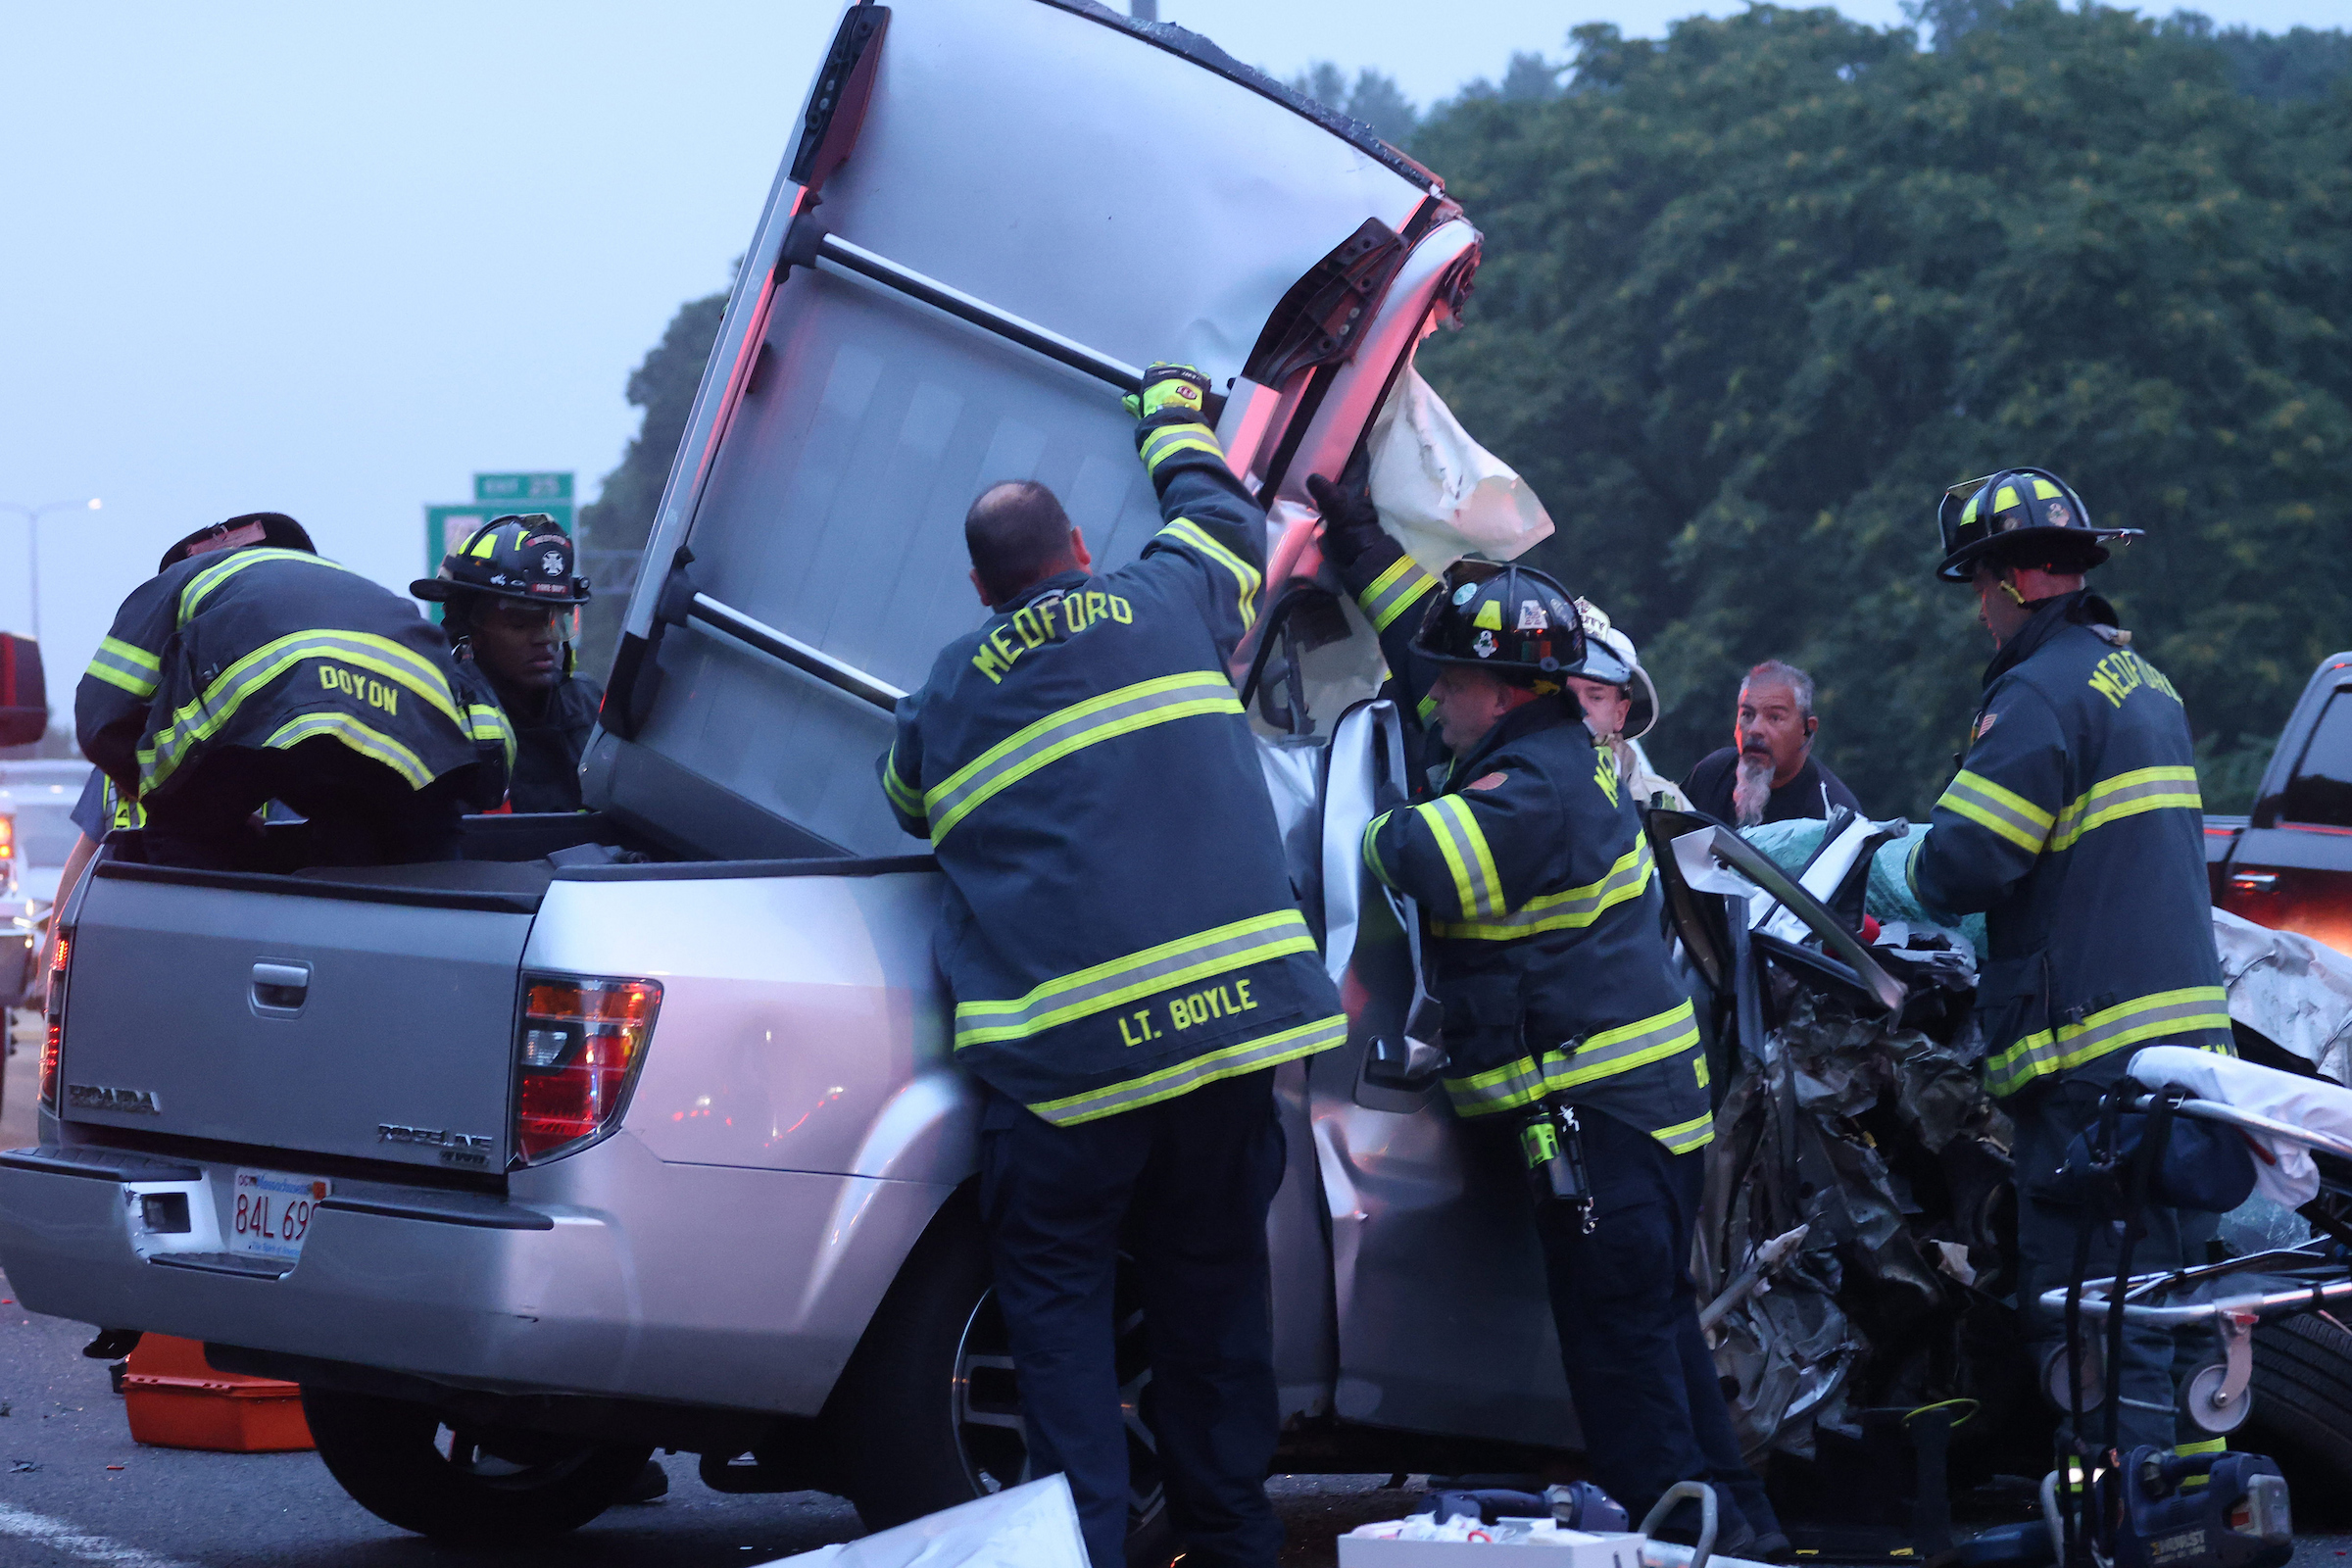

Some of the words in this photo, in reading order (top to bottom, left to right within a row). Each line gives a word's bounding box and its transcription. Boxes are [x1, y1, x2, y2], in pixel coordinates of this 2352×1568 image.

[971, 590, 1134, 684] MEDFORD
[318, 664, 398, 716] DOYON
[1118, 1008, 1163, 1048] LT.
[1169, 978, 1258, 1031] BOYLE
[236, 1193, 274, 1239] 84L
